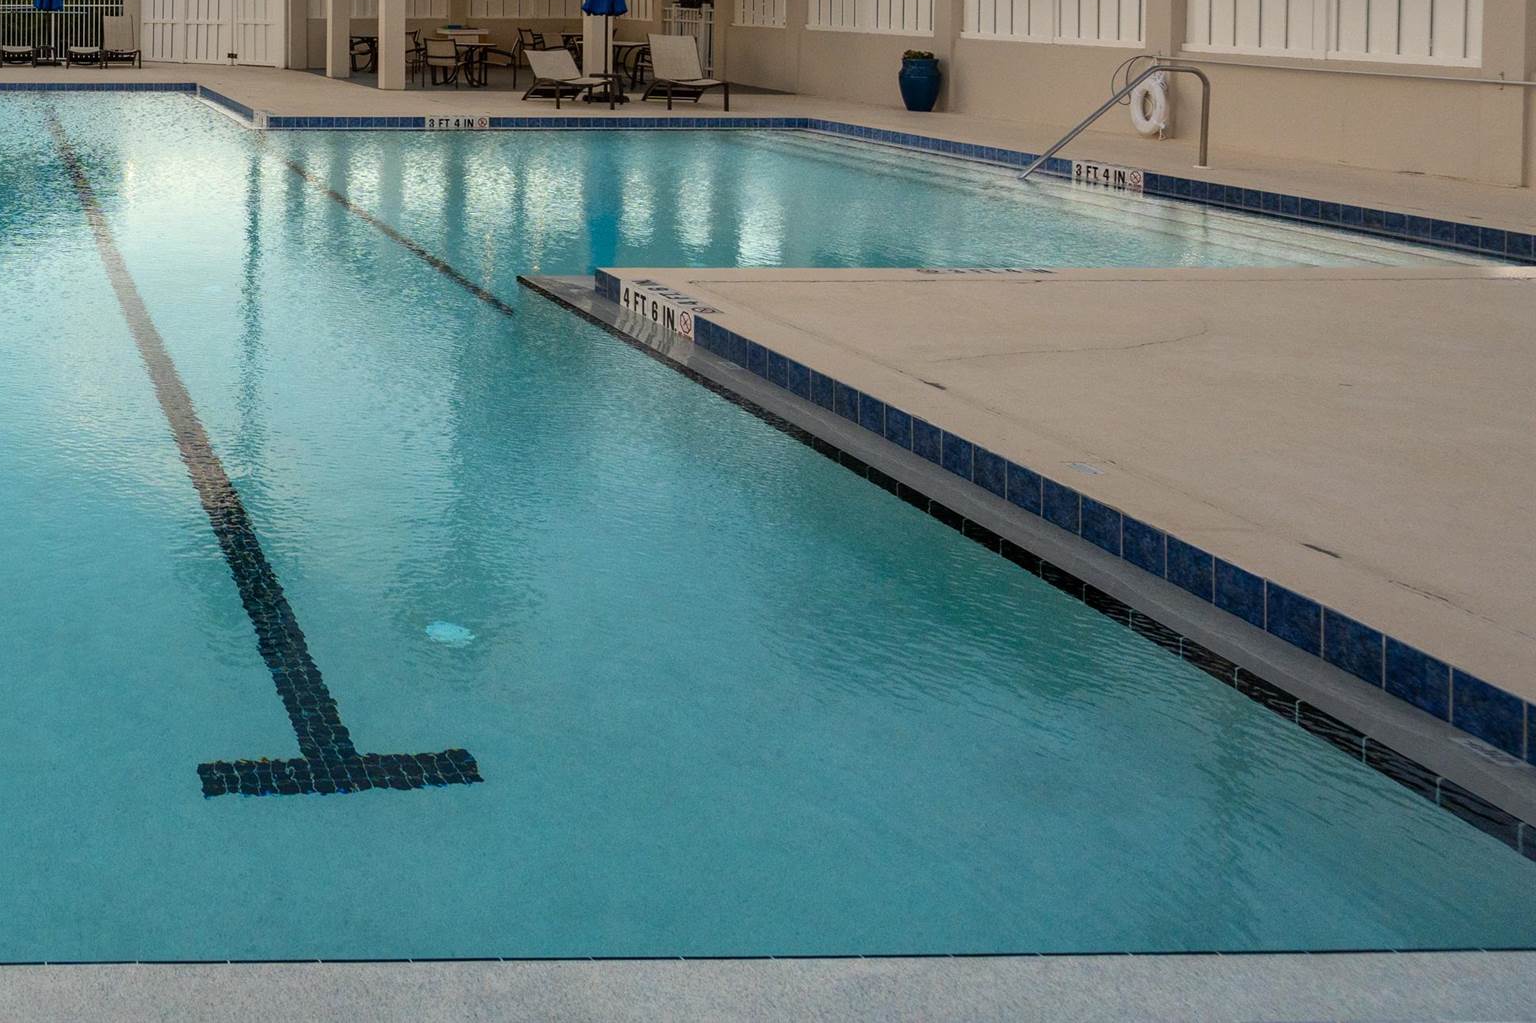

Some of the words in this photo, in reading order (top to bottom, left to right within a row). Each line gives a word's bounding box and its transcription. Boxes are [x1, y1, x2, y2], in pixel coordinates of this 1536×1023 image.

[428, 118, 435, 128] 3
[454, 118, 460, 128] 4
[1075, 164, 1082, 176] 3
[1102, 168, 1110, 181] 4
[623, 287, 630, 308] 4
[651, 300, 658, 322] 6
